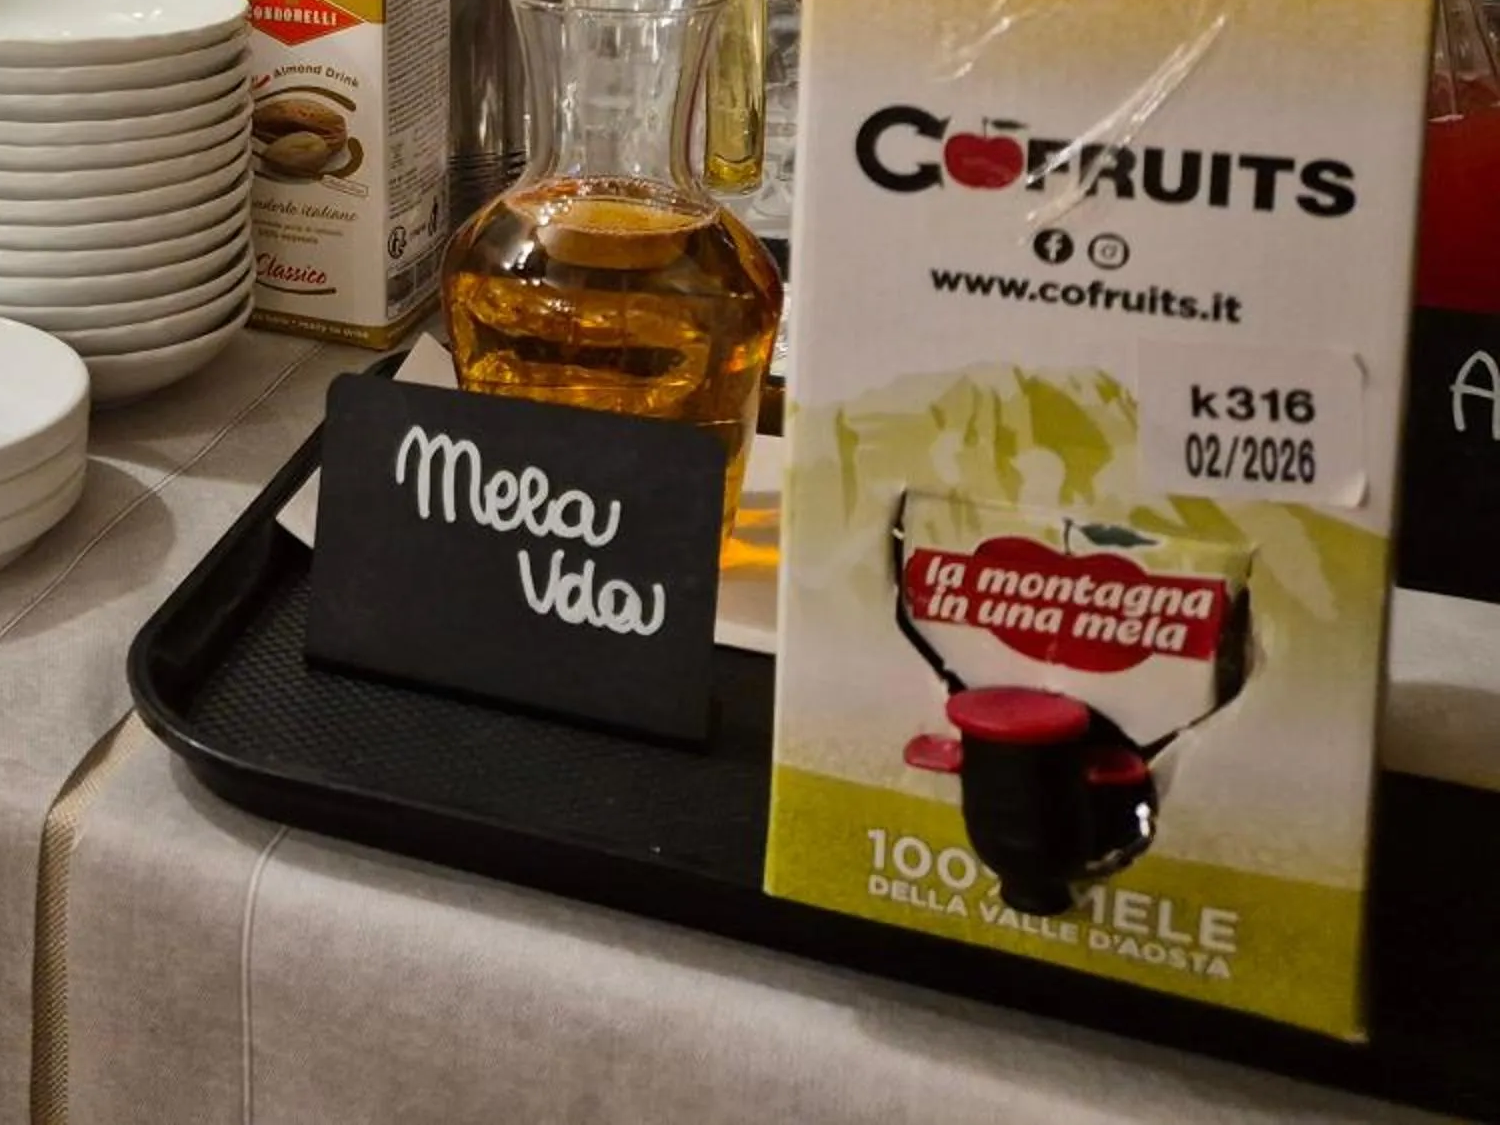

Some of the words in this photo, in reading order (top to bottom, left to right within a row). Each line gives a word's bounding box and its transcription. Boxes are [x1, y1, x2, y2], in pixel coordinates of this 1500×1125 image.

[273, 63, 323, 79] Almond
[325, 66, 360, 88] Drink
[256, 252, 328, 285] Classico
[930, 267, 1242, 324] www.cofruits.it
[1190, 383, 1316, 424] k316
[396, 424, 621, 547] Mela
[1185, 432, 1316, 484] 02/2026
[925, 555, 965, 589] la
[976, 566, 1214, 619] montagna
[927, 586, 969, 622] in
[977, 598, 1064, 633] una
[1072, 610, 1188, 652] mela
[868, 874, 969, 917] DELLA
[979, 900, 1079, 945] VALLE
[1088, 928, 1231, 979] D'AOSTA
